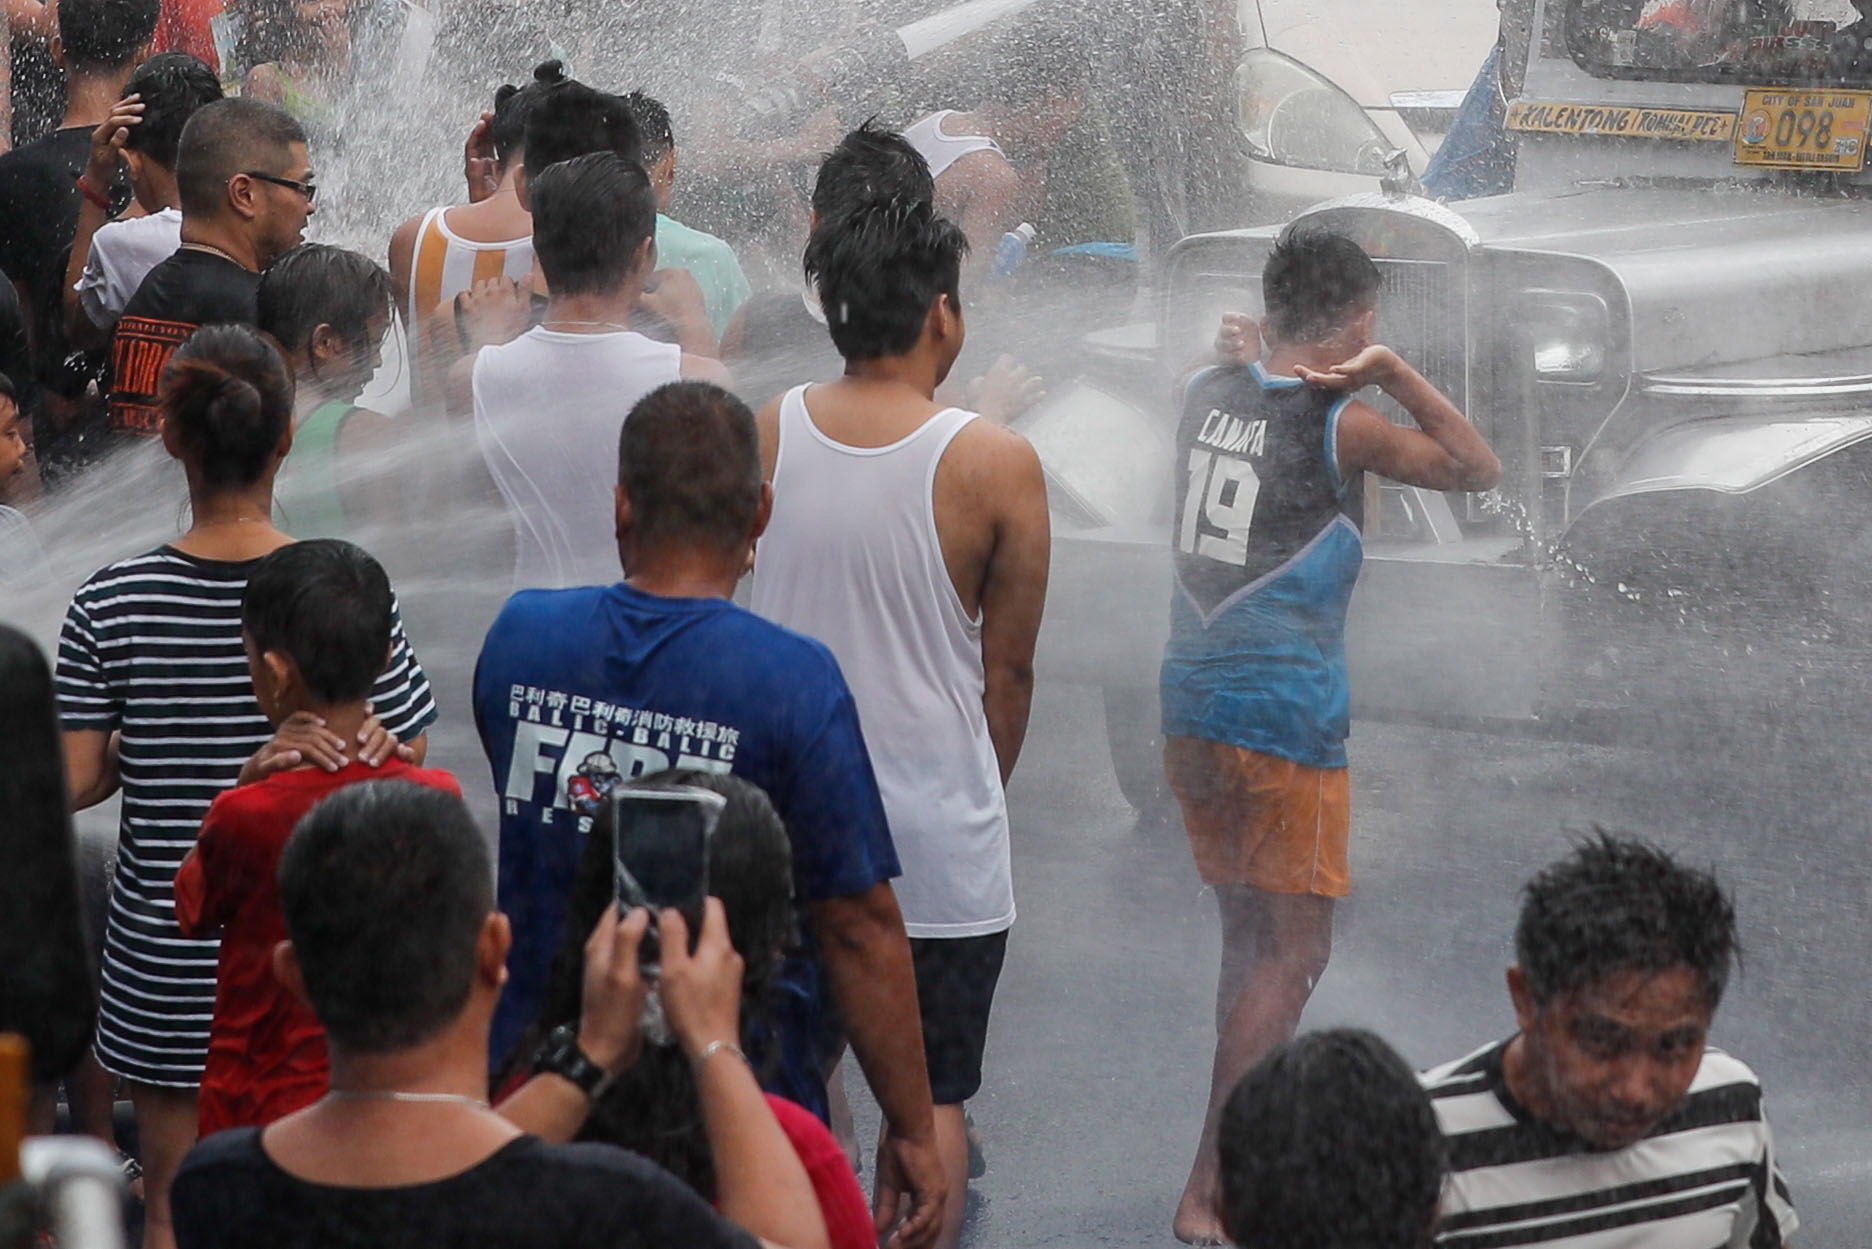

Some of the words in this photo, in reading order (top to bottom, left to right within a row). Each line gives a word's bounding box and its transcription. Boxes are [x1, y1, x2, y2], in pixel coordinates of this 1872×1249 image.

[1804, 96, 1825, 107] SAN
[1828, 97, 1856, 109] JUAN
[1775, 109, 1834, 149] 098
[1179, 448, 1261, 566] 19
[509, 701, 737, 761] BALIC-BALIC
